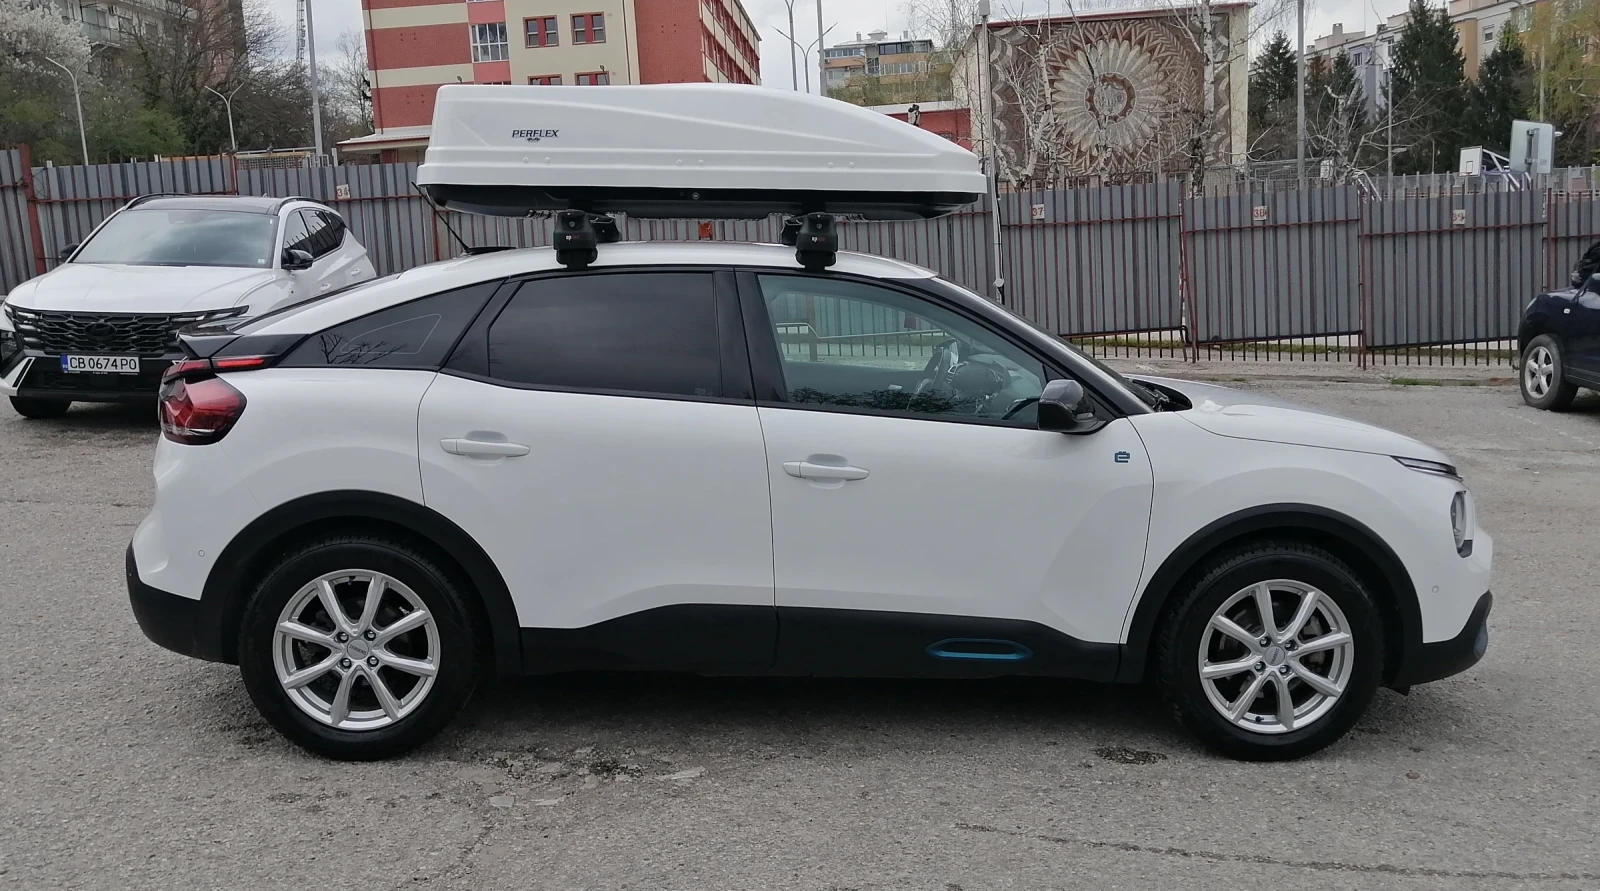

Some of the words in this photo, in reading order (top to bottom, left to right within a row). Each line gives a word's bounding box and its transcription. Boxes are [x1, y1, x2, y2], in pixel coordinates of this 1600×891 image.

[511, 129, 559, 138] PERFLEX
[1031, 207, 1044, 217] 37
[69, 357, 86, 369] CB
[88, 357, 118, 370] 0674
